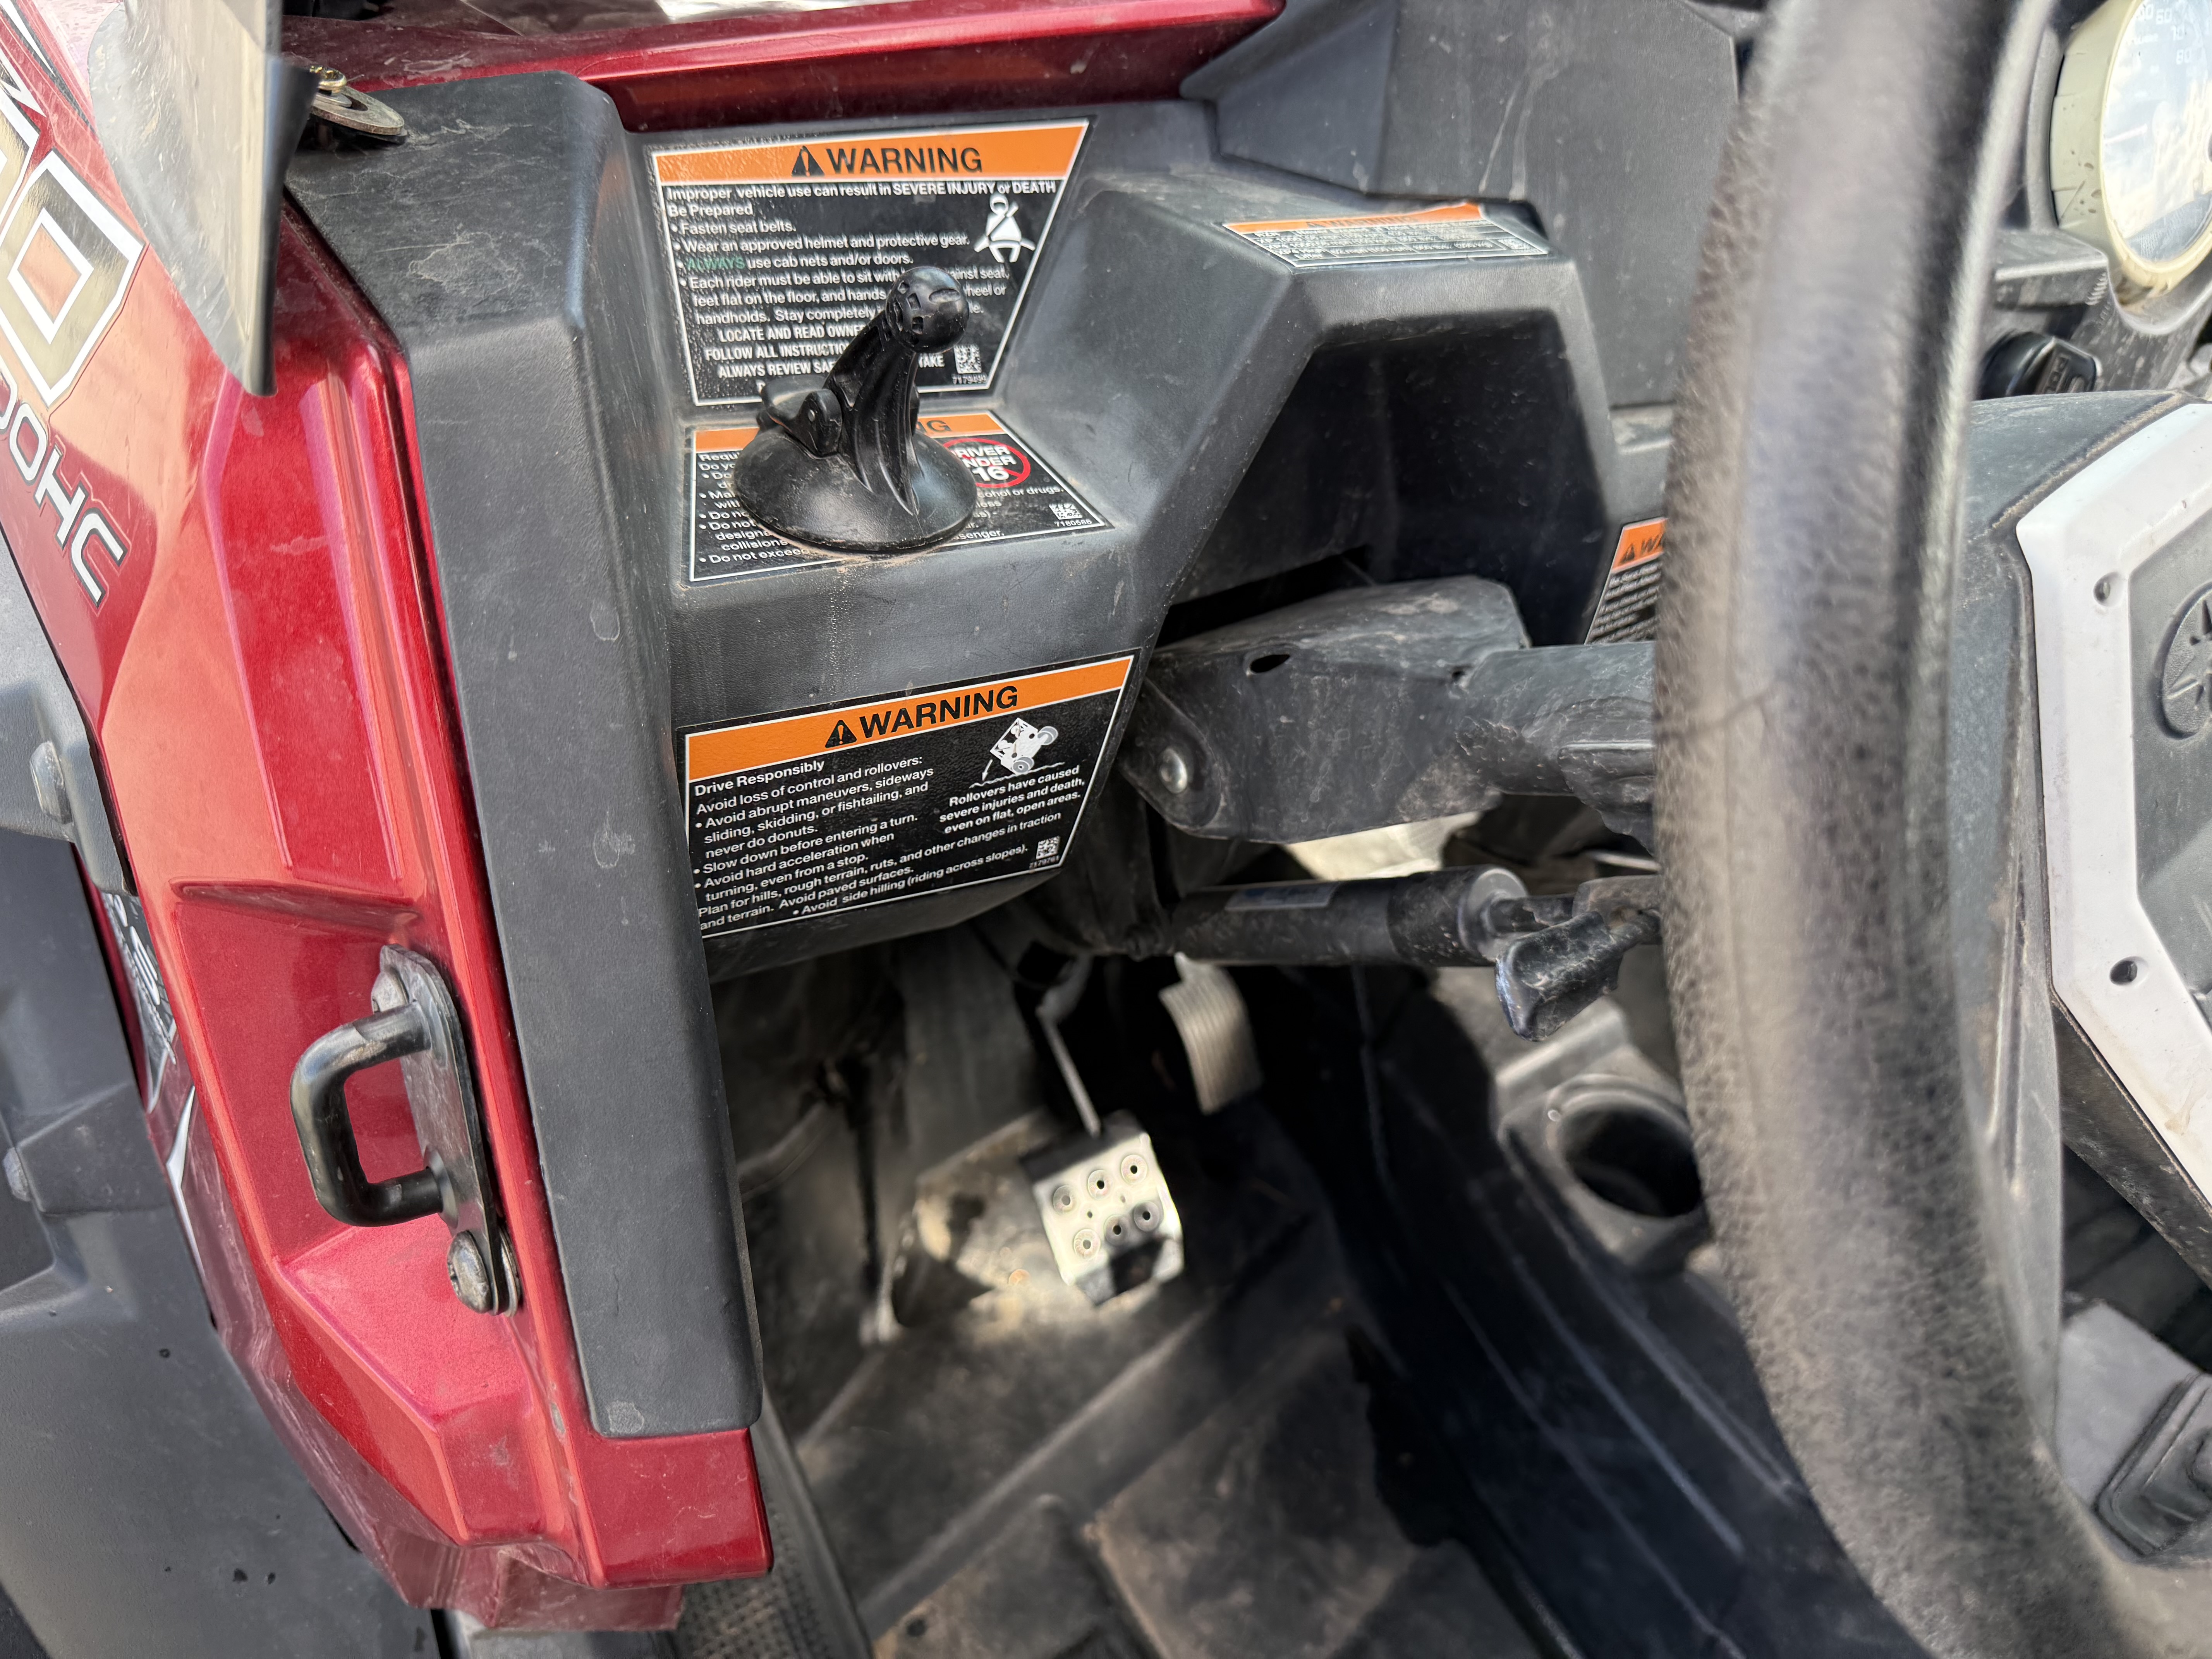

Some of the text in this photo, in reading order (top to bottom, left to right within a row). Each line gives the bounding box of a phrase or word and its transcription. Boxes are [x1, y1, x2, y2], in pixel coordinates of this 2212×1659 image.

[826, 147, 982, 174] WARNING
[667, 180, 1056, 202] Improper vehicle use can result in SEVERE INJURY or DEATH
[668, 201, 754, 218] Be Prepared
[681, 218, 797, 235] Fasten seat belts.
[683, 232, 970, 253] Wear an approved helmet and protective gear.
[686, 251, 914, 271] ALWAYS use cab nets and/or doors.
[690, 267, 900, 289] Each rider must be able to sit with
[693, 286, 887, 307] feet flat on the floor, and hands
[695, 304, 876, 325] handholds. Stay completely
[718, 326, 765, 343] LOCATE
[766, 325, 792, 340] AND
[793, 323, 825, 339] READ
[704, 341, 849, 361] FOLLOW ALL INSTRUCTIO
[718, 361, 836, 378] ALWAYS REVIEW SAF
[961, 455, 1017, 468] NDER
[972, 466, 1010, 481] 16
[1012, 488, 1025, 496] or
[1026, 485, 1065, 495] drugs.
[708, 511, 730, 520] Do
[708, 520, 757, 531] Do not
[715, 530, 771, 541] designa
[721, 539, 788, 551] collisions
[951, 529, 1005, 541] ssenger.
[709, 554, 731, 563] Do
[732, 551, 758, 561] not
[860, 685, 1018, 739] WARNING
[694, 760, 825, 796] Drive Responsibly
[696, 756, 923, 815] Avoid loss of control and rollovers:
[949, 765, 1080, 807] Rollovers have caused
[705, 768, 934, 828] Avoid abrupt maneuvers, sideways
[939, 777, 1085, 823] severe injuries and death,
[704, 781, 929, 844] sliding, skidding, or fishtailing, and
[944, 791, 1082, 834] even on flat, open areas.
[702, 814, 918, 874] Slow down before entering a turn.
[705, 825, 819, 859] never do donuts.
[698, 812, 1062, 917] Plan for hills, rough terrain, ruts, and other changes in traction
[703, 833, 895, 888] Avoid hard acceleration when
[705, 854, 869, 902] turning, even from a stop.
[800, 897, 838, 915] Avoid
[842, 890, 869, 903] side
[869, 880, 906, 896] hilling
[907, 869, 944, 887] (riding
[945, 856, 985, 875] across
[985, 843, 1029, 862] slopes).
[700, 866, 914, 930] and terrain. Avoid paved surfaces.
